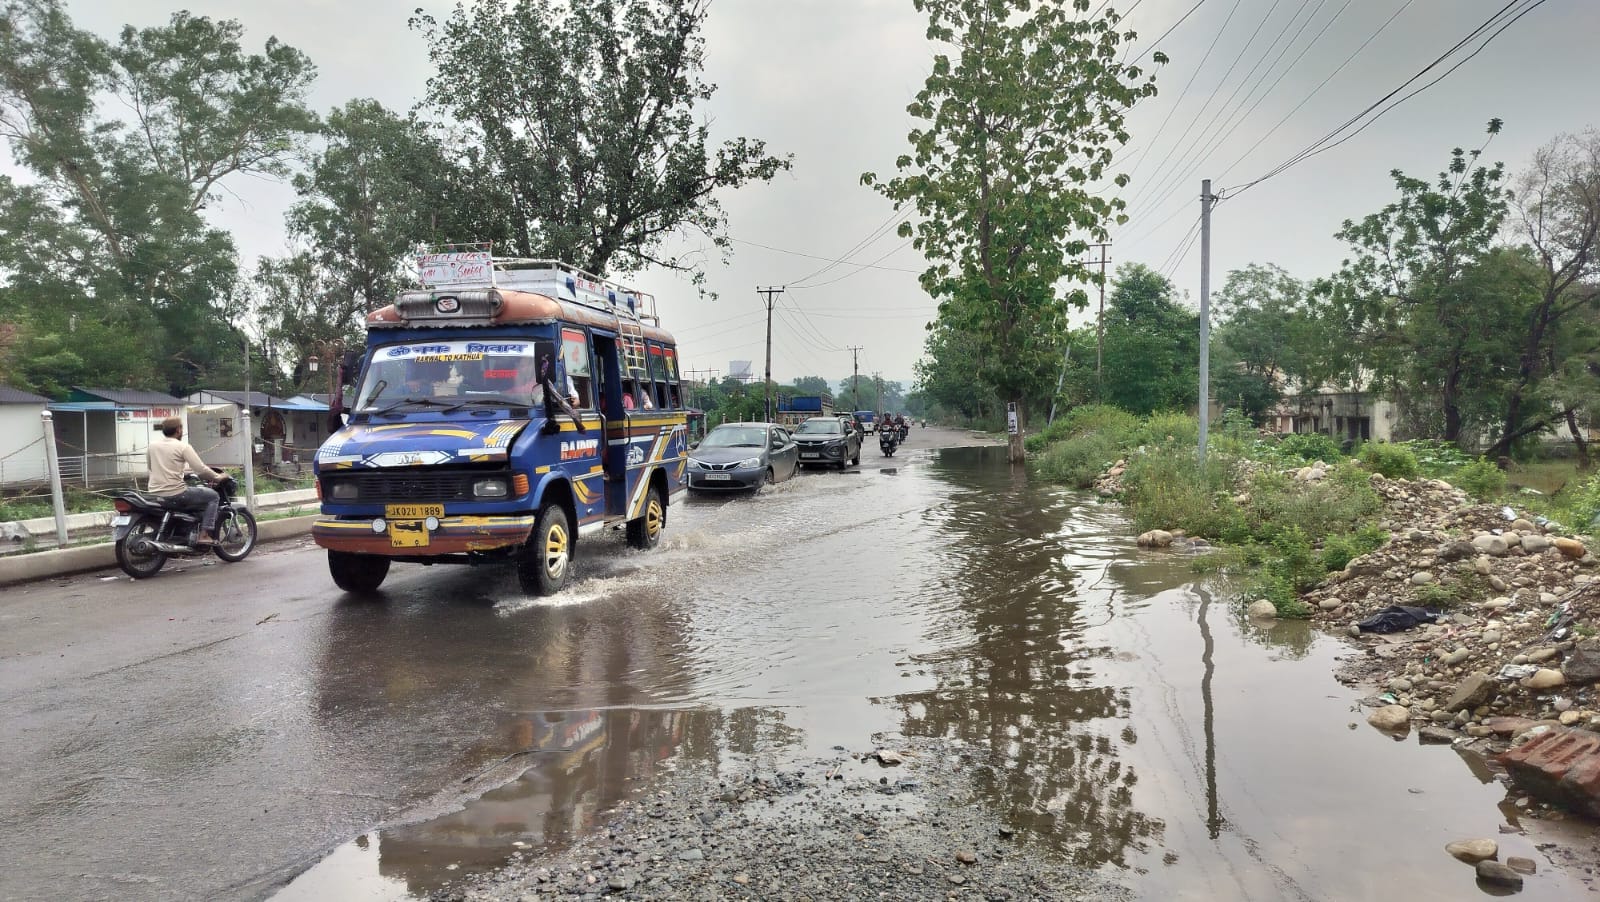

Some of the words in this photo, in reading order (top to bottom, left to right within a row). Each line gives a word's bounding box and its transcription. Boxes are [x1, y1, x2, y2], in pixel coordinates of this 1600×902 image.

[465, 342, 528, 353] शिवाय
[444, 354, 453, 362] TO
[453, 353, 481, 362] KATHUA
[560, 439, 598, 459] RAJPUT
[391, 507, 417, 516] JK02U
[420, 506, 441, 516] 1889
